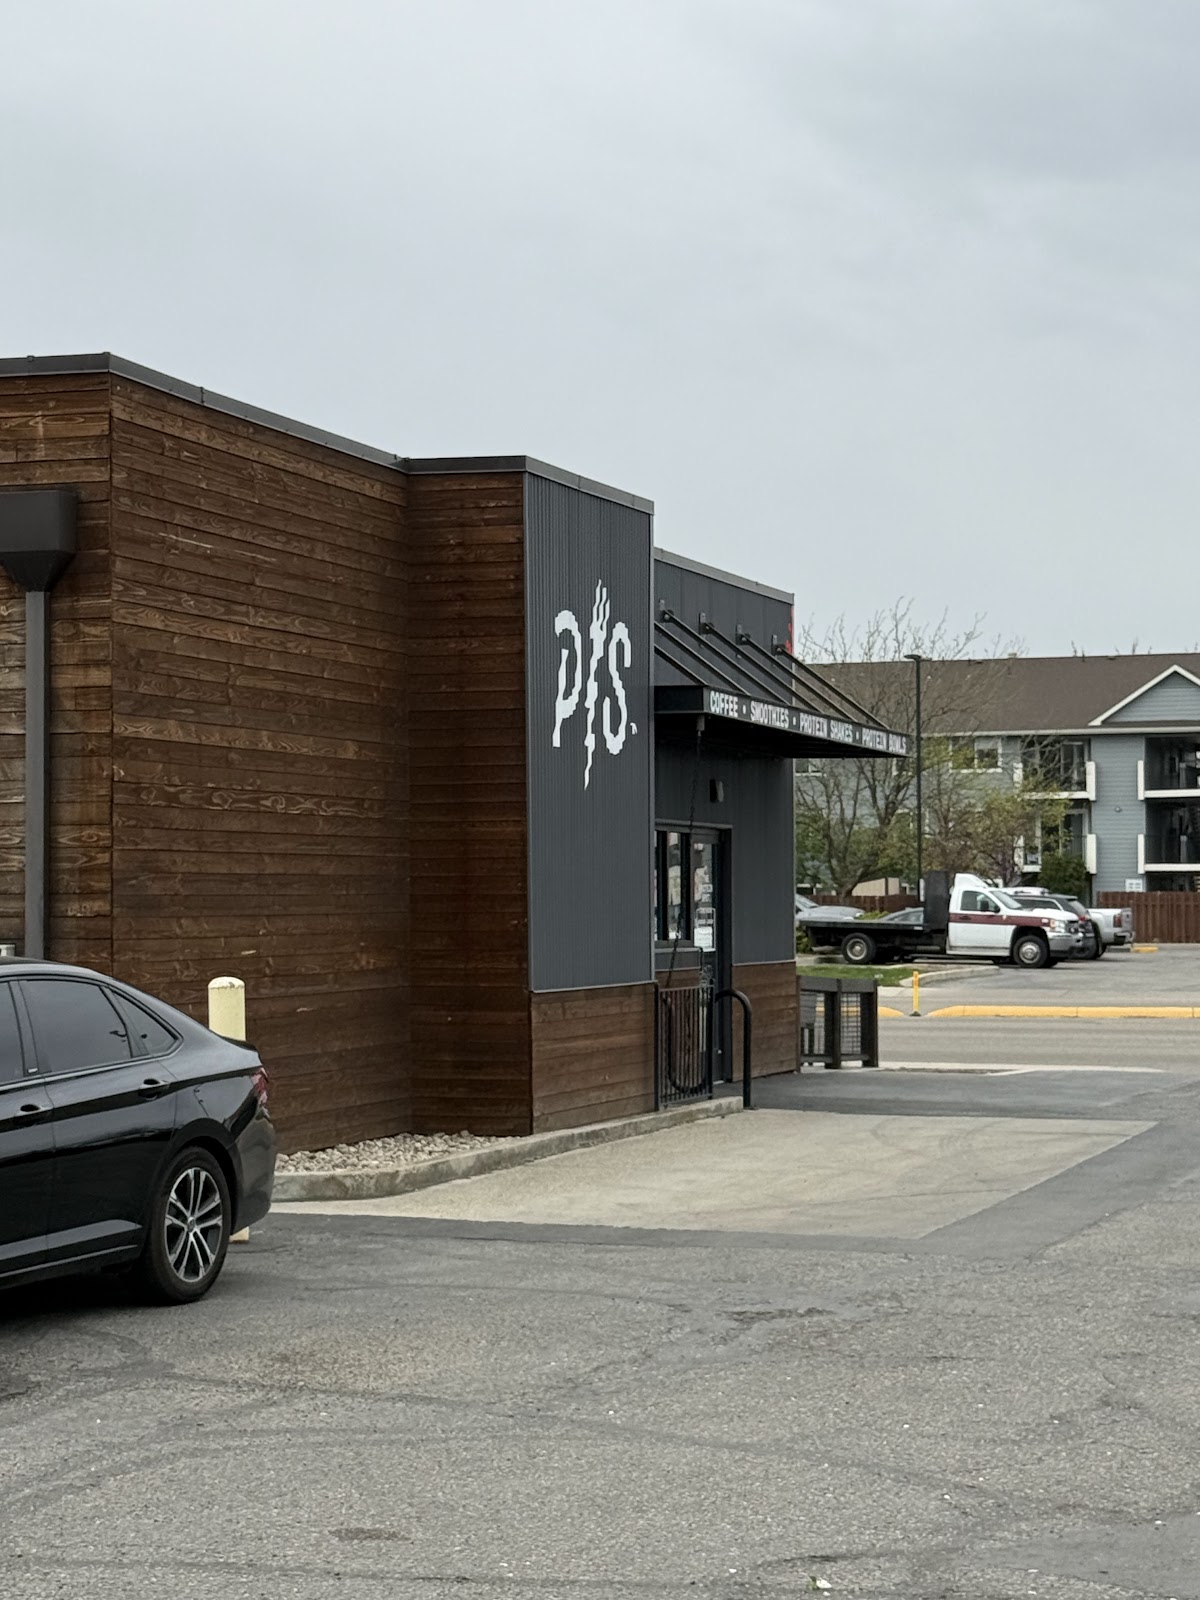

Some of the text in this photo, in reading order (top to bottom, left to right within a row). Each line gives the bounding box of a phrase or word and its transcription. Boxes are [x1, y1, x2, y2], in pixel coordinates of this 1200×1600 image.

[709, 690, 739, 718] COFFEE
[750, 700, 790, 729] SMOOTHIES
[799, 712, 828, 738] PROTEIN
